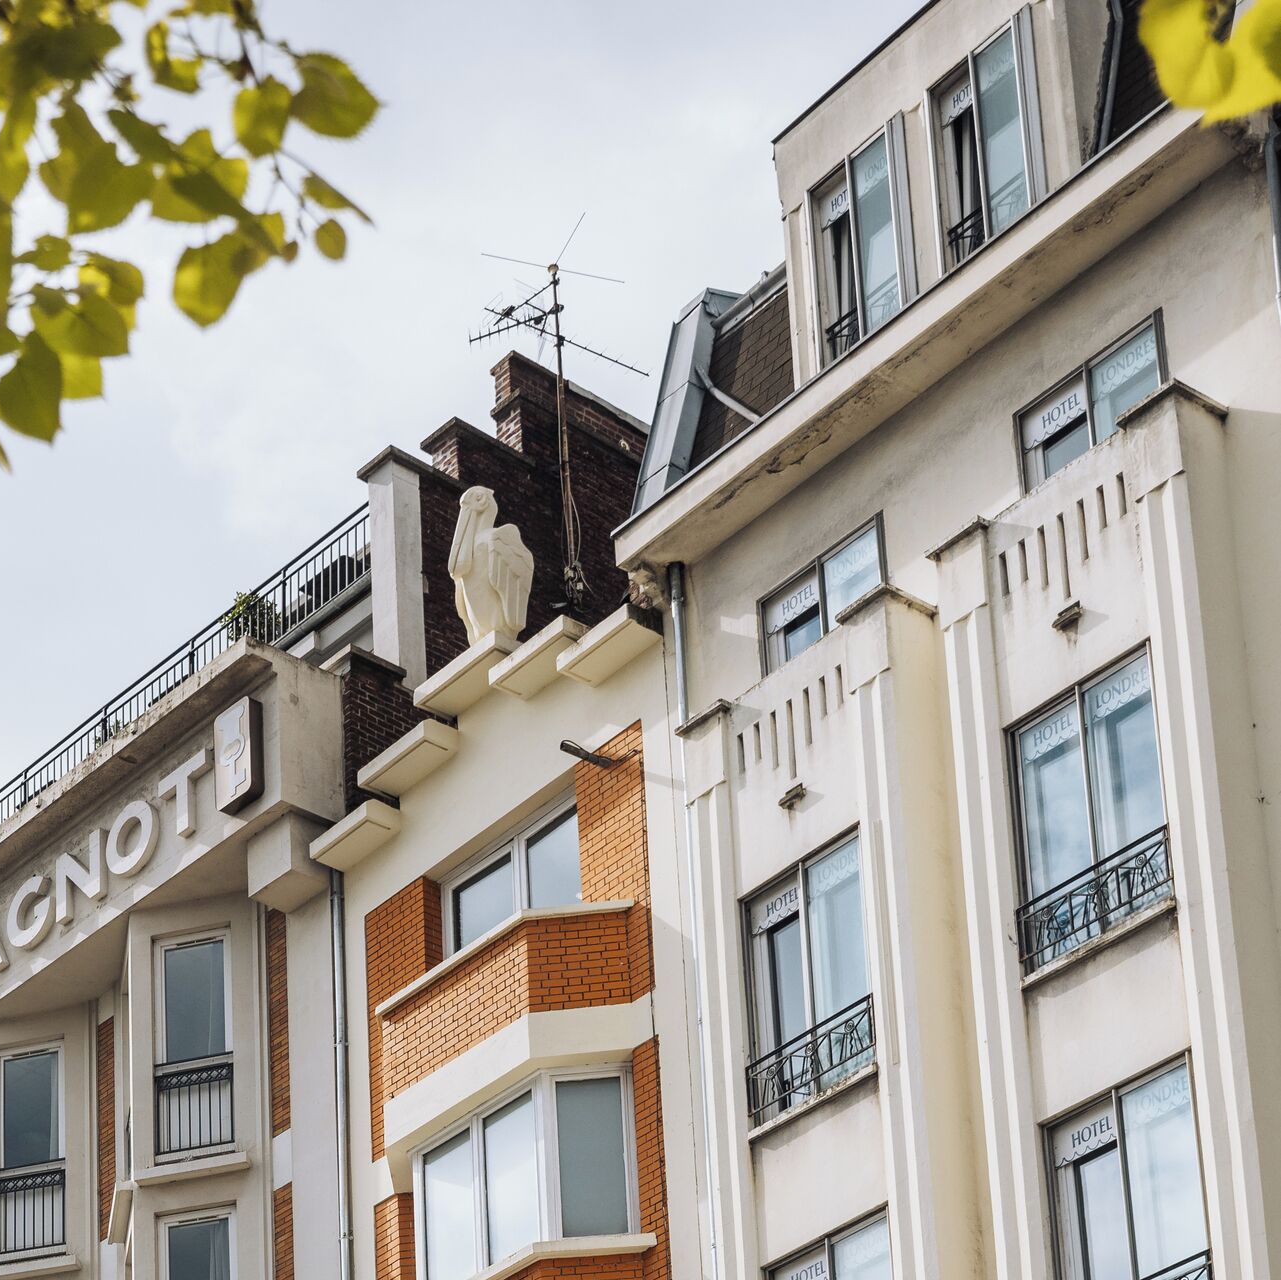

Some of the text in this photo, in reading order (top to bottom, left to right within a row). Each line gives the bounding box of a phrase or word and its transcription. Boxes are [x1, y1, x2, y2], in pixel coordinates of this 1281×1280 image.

[952, 84, 970, 108] HOT
[830, 189, 848, 213] HOT
[1040, 393, 1080, 429] HOTEL
[781, 584, 815, 616] HOTEL
[1032, 666, 1149, 748] HOTEL LONDRE
[765, 887, 799, 918] HOTEL
[1071, 1076, 1189, 1148] HOTEL LONDRE
